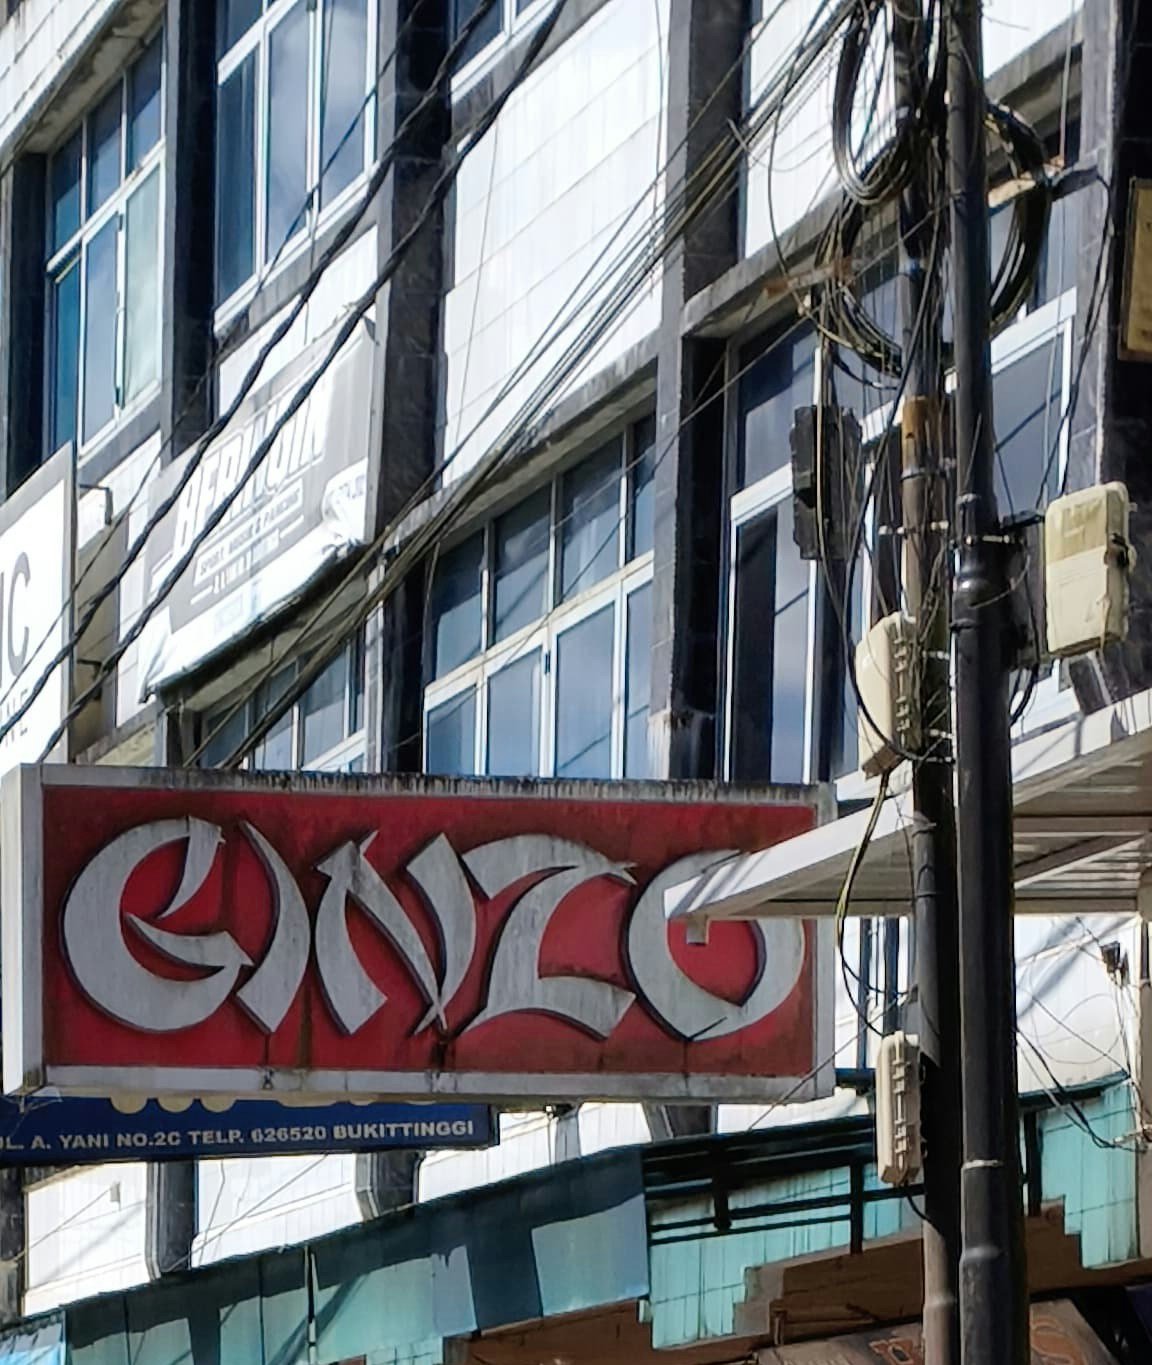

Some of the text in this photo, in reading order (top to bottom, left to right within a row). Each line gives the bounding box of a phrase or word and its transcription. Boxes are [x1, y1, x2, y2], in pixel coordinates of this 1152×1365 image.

[32, 1135, 52, 1149] A.
[60, 1132, 108, 1149] YANI
[187, 1127, 244, 1146] TELP.
[251, 1122, 327, 1143] 626520
[334, 1119, 474, 1139] BUKITTINGGI
